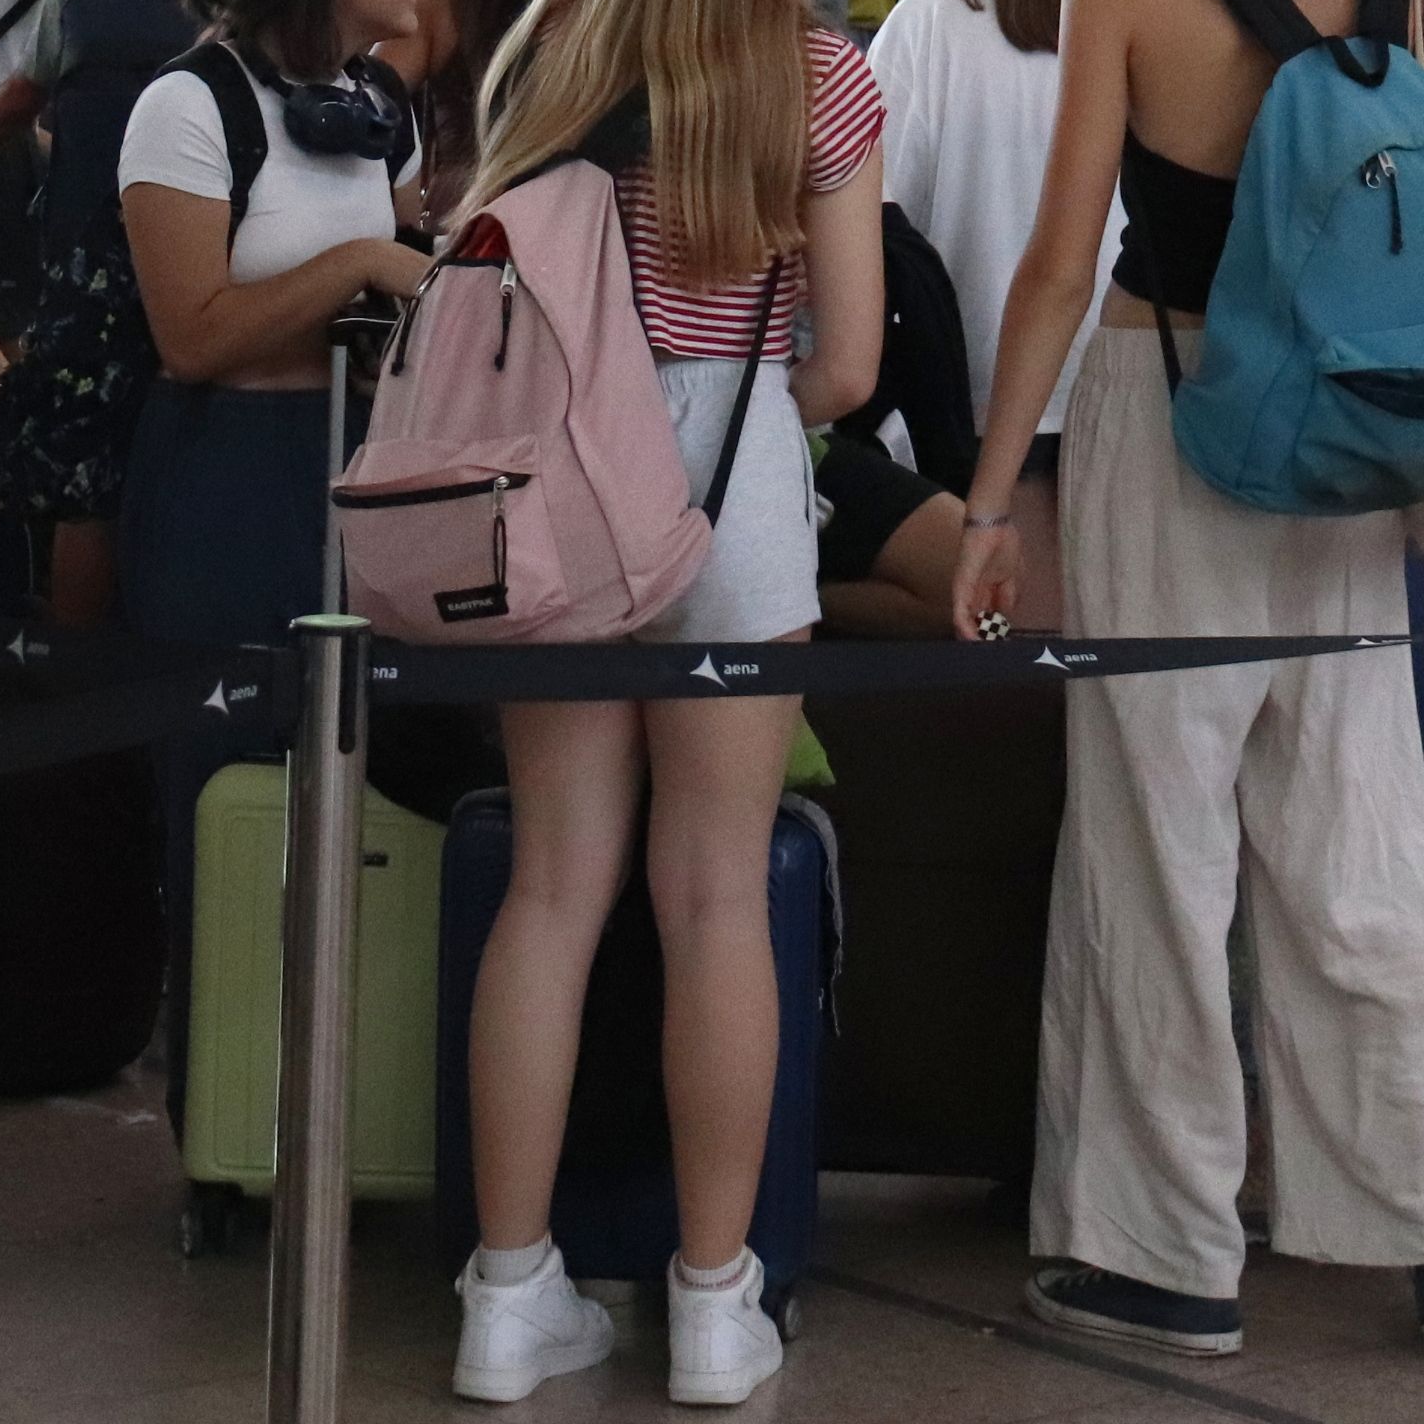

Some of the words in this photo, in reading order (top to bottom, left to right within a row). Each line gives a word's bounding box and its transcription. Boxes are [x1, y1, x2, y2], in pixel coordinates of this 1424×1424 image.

[447, 598, 494, 611] EASTPAK
[1064, 651, 1099, 664] aena
[371, 666, 399, 680] ena
[723, 661, 759, 676] aena
[229, 683, 259, 702] aena
